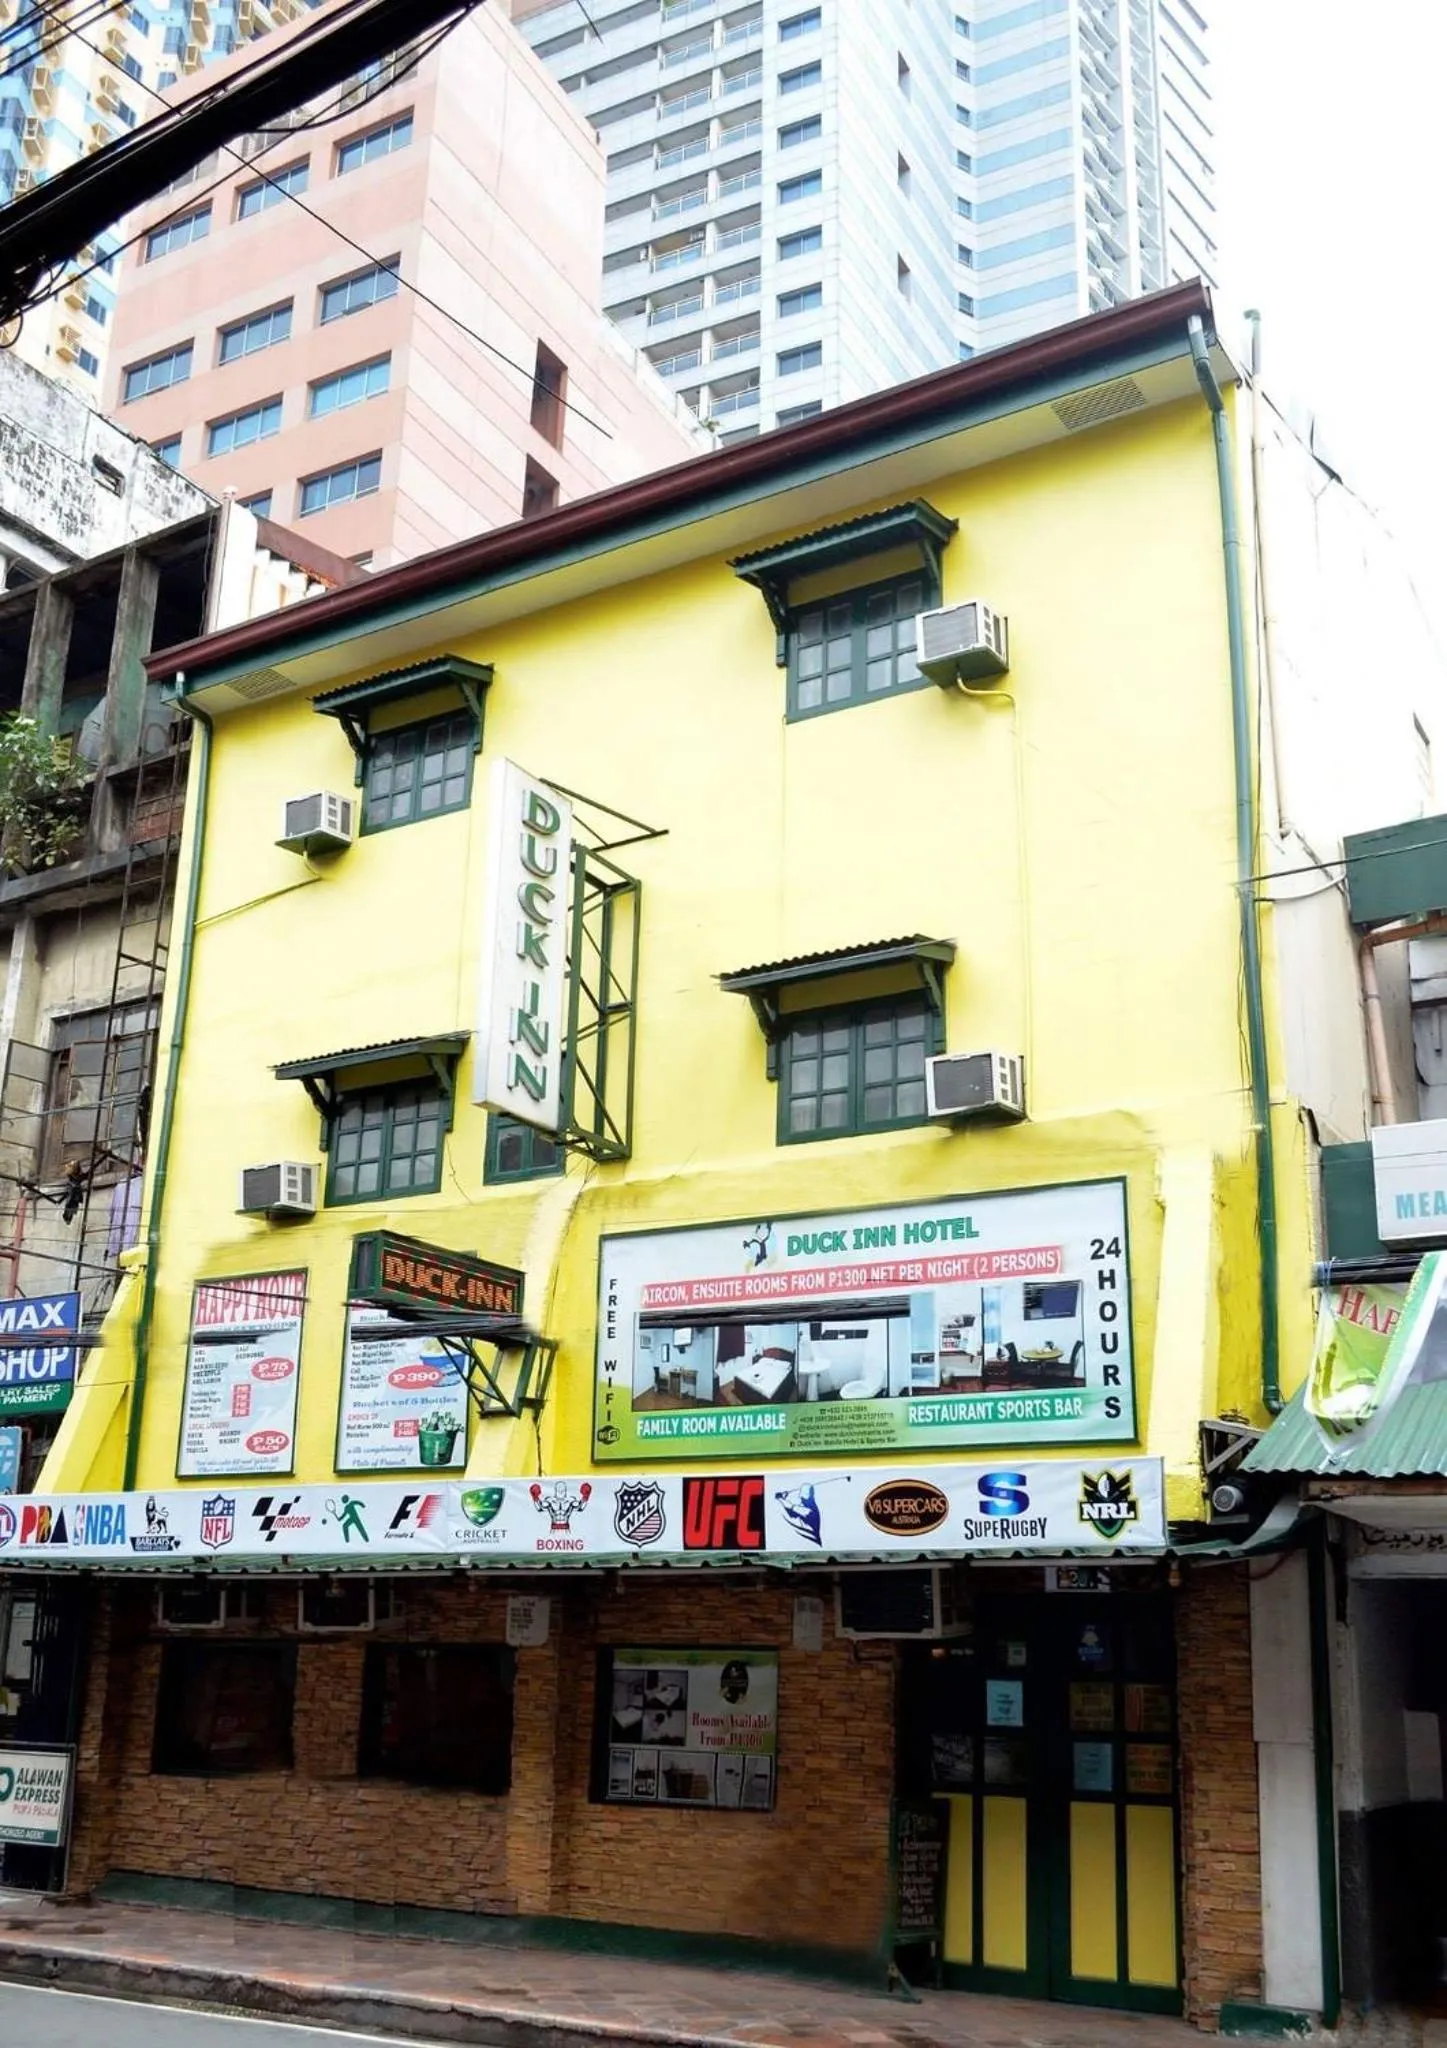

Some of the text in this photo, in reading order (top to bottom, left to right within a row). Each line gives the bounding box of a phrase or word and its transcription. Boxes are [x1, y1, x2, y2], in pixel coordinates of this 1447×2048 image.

[507, 790, 561, 1102] DUCK INN
[1396, 1190, 1447, 1220] MEA
[787, 1216, 980, 1256] DUCK INN HOTEL
[643, 1284, 689, 1304] AIRCON,
[692, 1281, 743, 1299] ENSUITE
[745, 1277, 788, 1295] ROOMS
[791, 1273, 825, 1291] FROM
[828, 1269, 867, 1287] P1300
[899, 1263, 923, 1280] PER
[927, 1258, 970, 1277] NIGHT
[973, 1255, 989, 1278] (2
[991, 1250, 1062, 1275] PERSONS)
[607, 1278, 618, 1339] FREE
[1090, 1237, 1122, 1418] 24 HOURS
[3, 1392, 54, 1404] PAYMENT
[909, 1402, 994, 1423] RESTAURANT
[997, 1399, 1050, 1419] SPORTS
[1054, 1397, 1083, 1417] BAR
[636, 1418, 679, 1436] FAMILY
[682, 1416, 717, 1433] ROOM
[720, 1413, 786, 1432] AVAILABLE
[626, 1499, 655, 1533] NHL
[685, 1479, 764, 1547] UFC
[882, 1497, 946, 1514] SUPERCARS
[1082, 1503, 1134, 1520] NRL
[20, 1505, 68, 1543] PBA
[84, 1504, 126, 1545] NBA
[204, 1518, 230, 1543] NFL
[455, 1530, 508, 1539] CRICKET
[536, 1539, 584, 1551] BOXING
[17, 1768, 63, 1787] ALAWAN
[15, 1787, 61, 1804] EXPRESS
